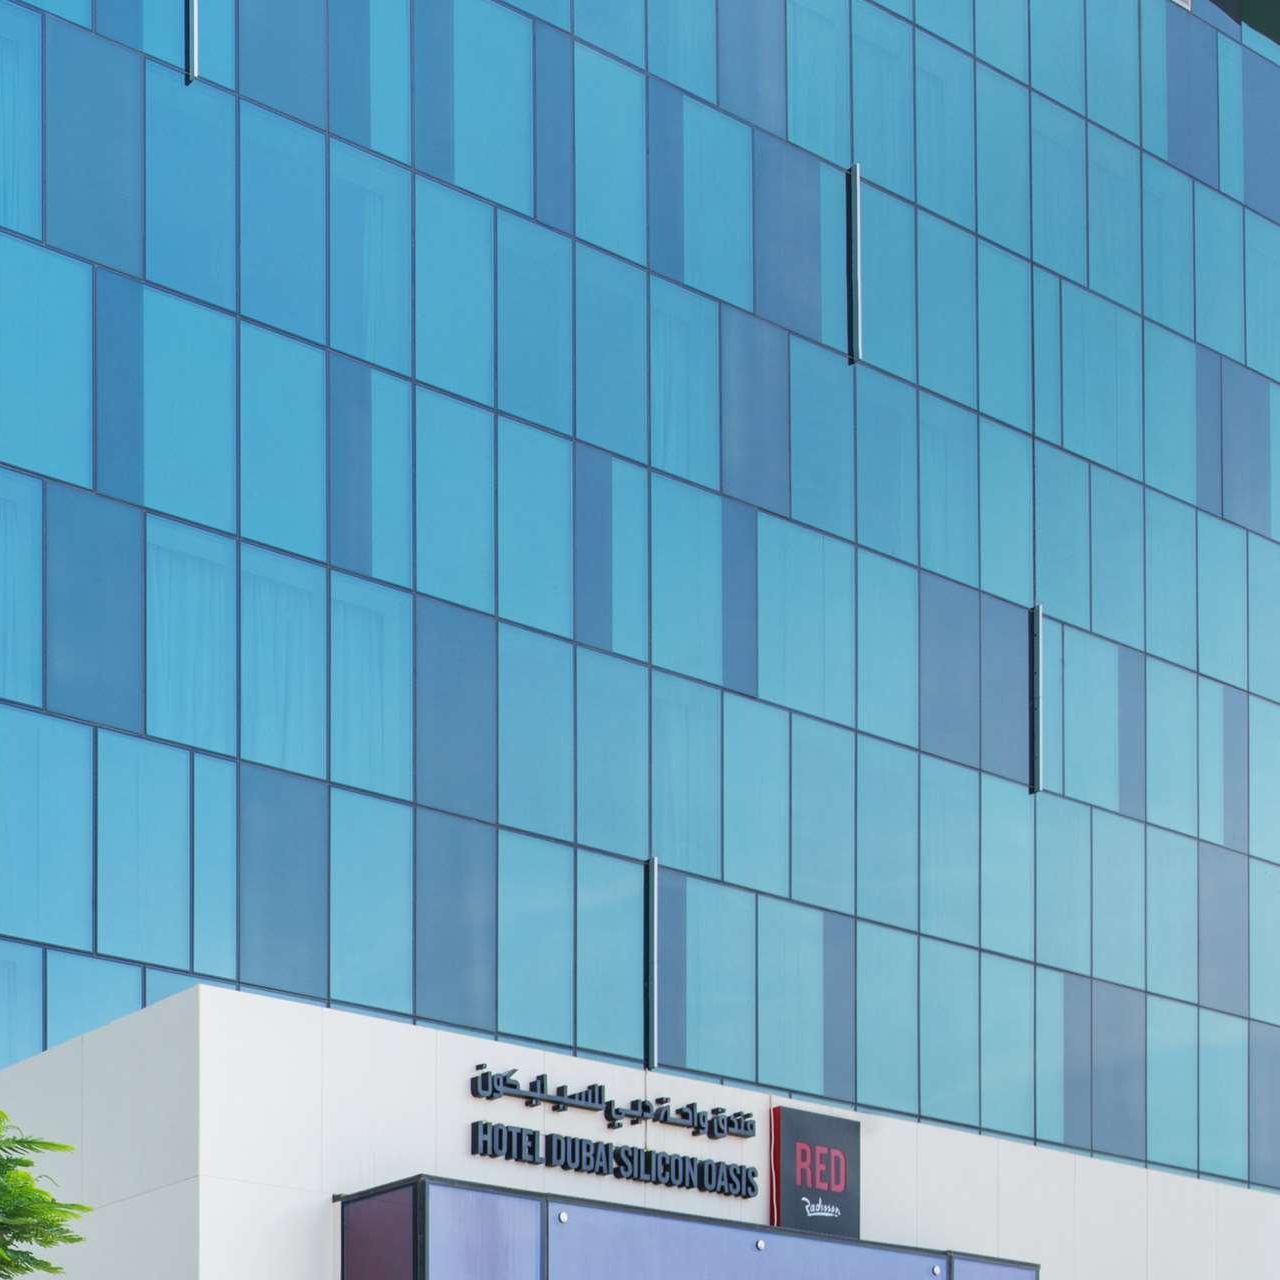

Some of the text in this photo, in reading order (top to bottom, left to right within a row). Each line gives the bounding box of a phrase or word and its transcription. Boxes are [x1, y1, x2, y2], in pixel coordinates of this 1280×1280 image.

[604, 1099, 655, 1129] دبي
[653, 1097, 708, 1136] واحة
[707, 1106, 756, 1139] فندق
[471, 1120, 759, 1198] HOTEL DUBAI SILICON OASIS
[795, 1141, 847, 1193] RED
[801, 1196, 842, 1217] Radisson
